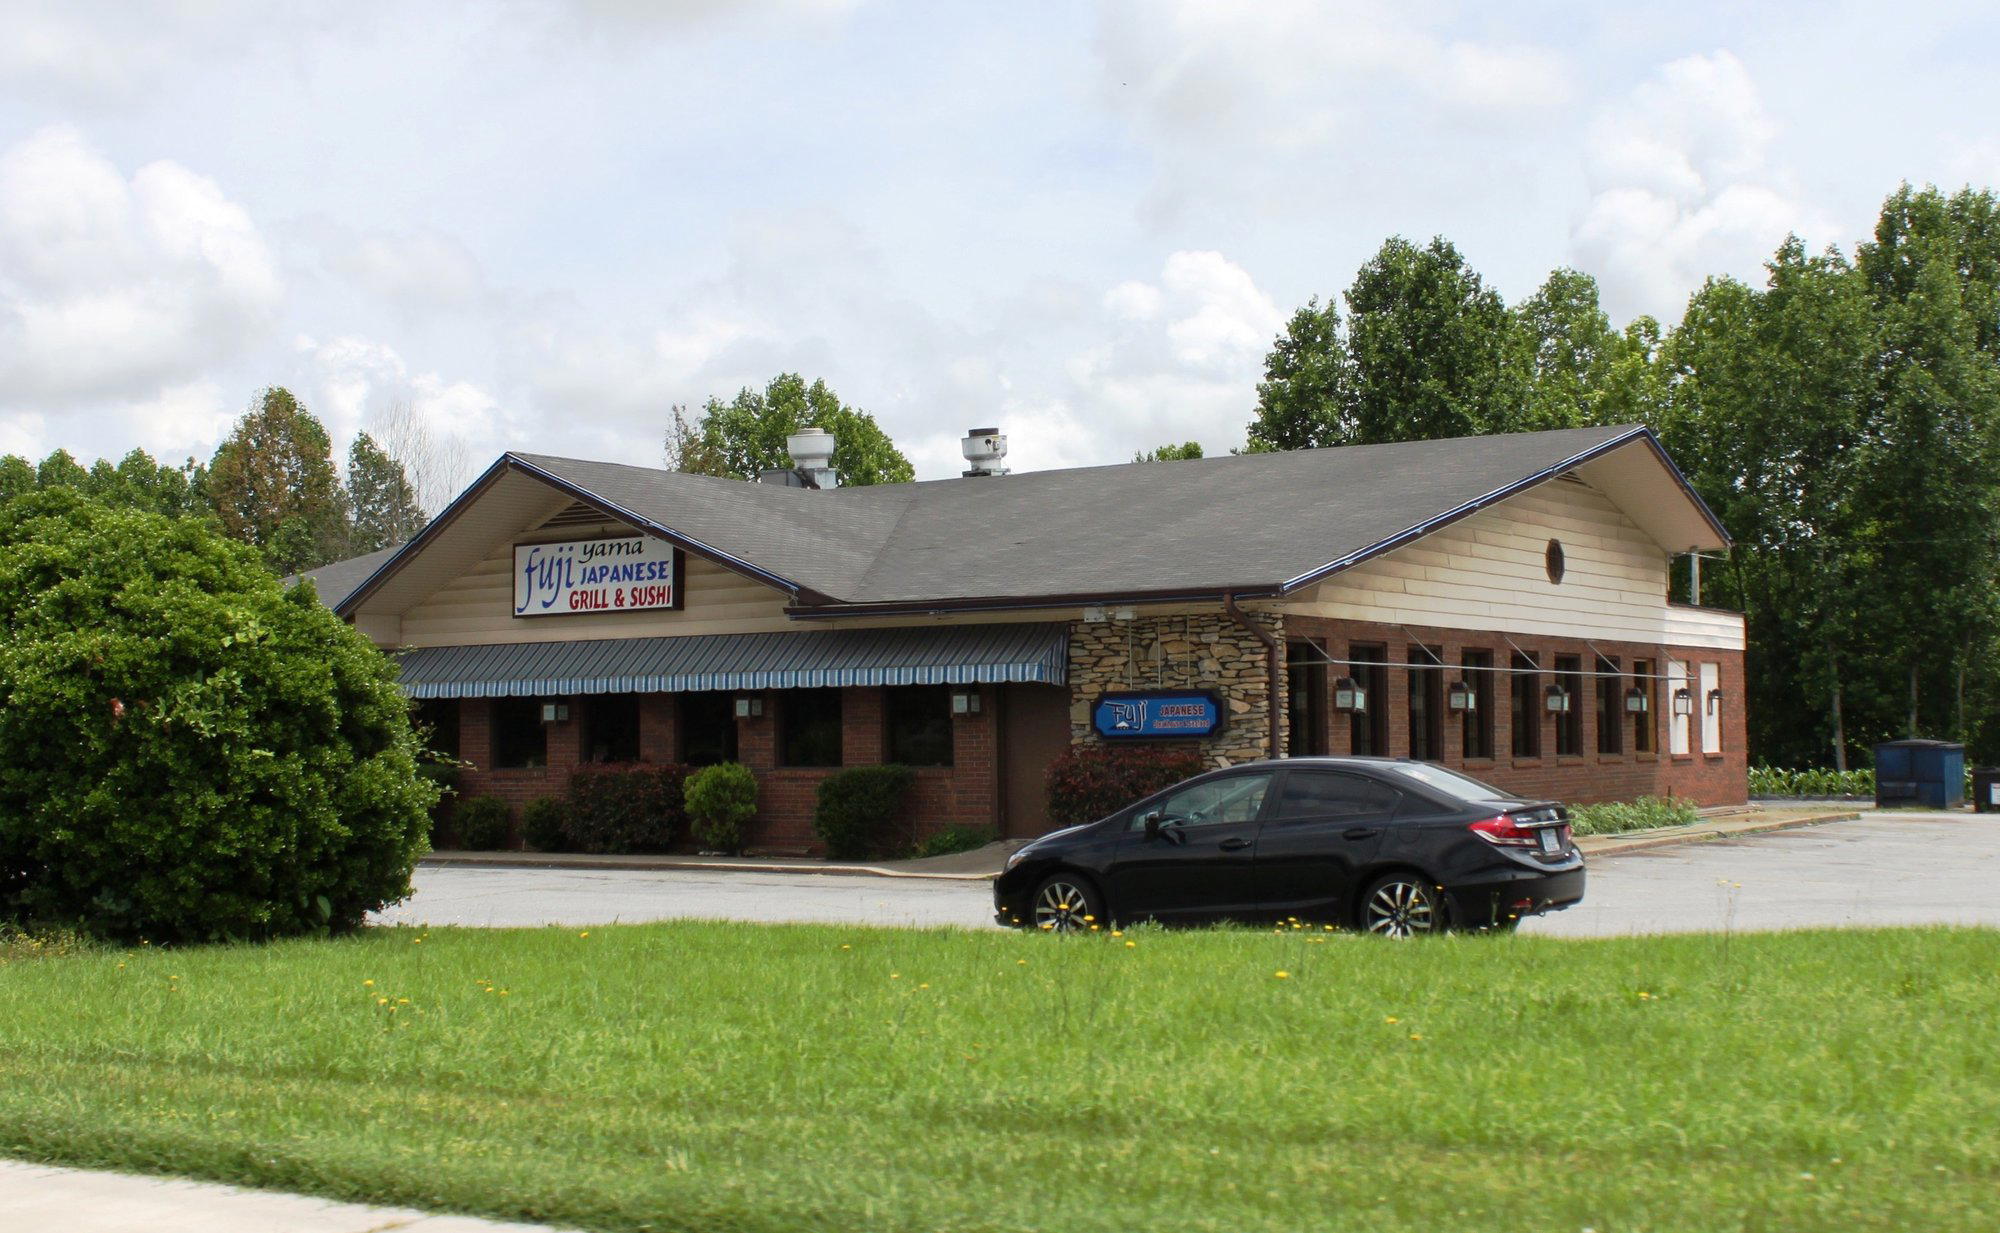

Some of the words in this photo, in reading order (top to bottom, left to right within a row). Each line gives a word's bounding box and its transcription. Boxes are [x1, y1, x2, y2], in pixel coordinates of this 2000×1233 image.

[516, 547, 575, 613] fuji
[578, 540, 644, 563] yama
[580, 560, 670, 586] JAPANESE
[569, 588, 609, 610] GRILL
[614, 588, 625, 608] &
[630, 585, 671, 607] SUSHI
[1160, 704, 1206, 717] JAPANESE
